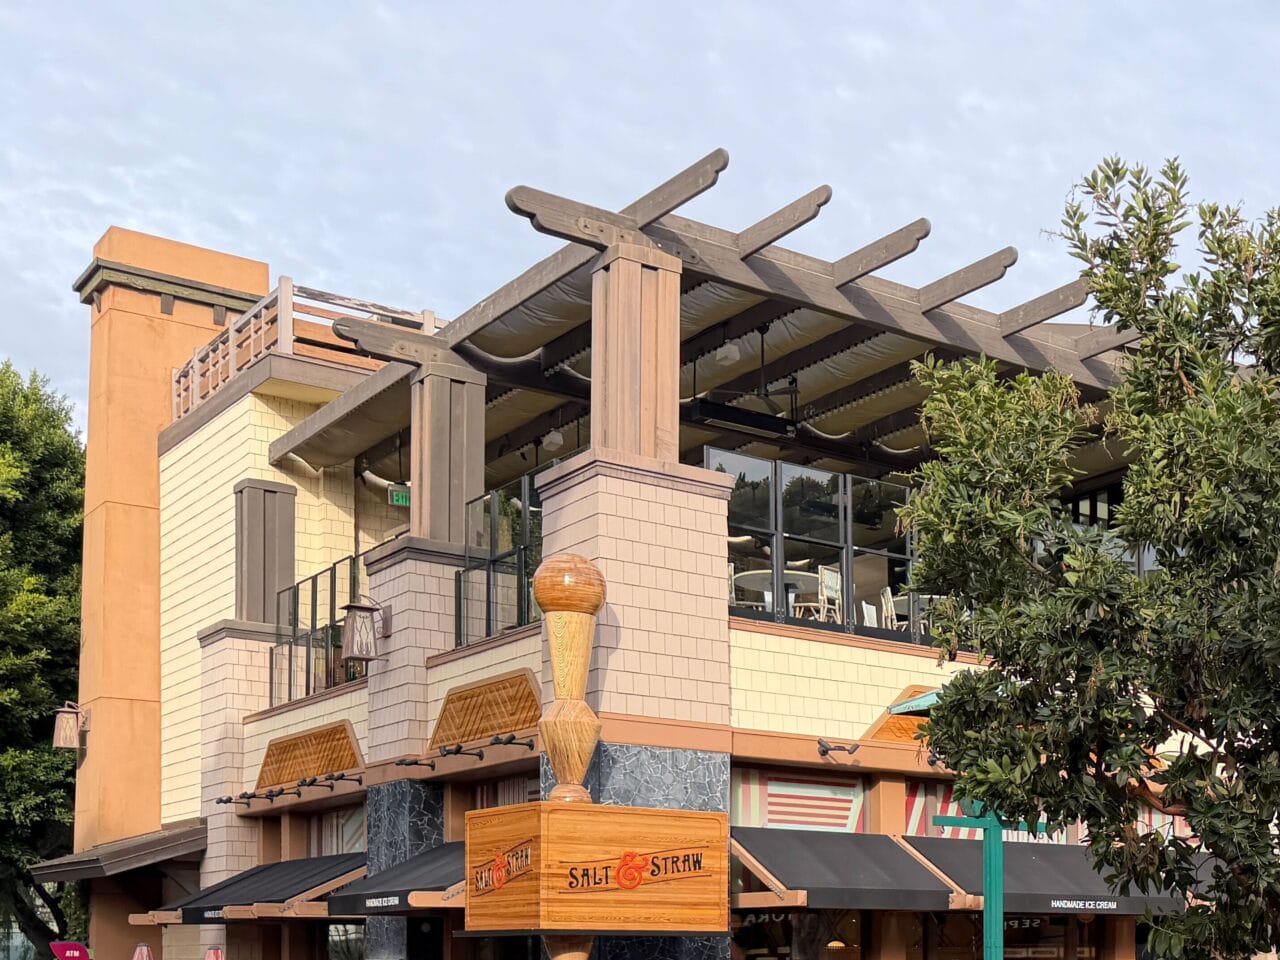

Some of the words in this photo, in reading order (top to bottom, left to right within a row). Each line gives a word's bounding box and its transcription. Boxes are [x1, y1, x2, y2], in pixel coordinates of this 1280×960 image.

[475, 868, 494, 892] SALT
[493, 852, 507, 890] &
[506, 847, 531, 876] STRAW
[568, 865, 612, 889] SALT
[615, 851, 649, 889] &
[650, 852, 704, 877] STRAW
[1051, 899, 1085, 909] HANDMADE
[1085, 901, 1095, 909] ICE
[1096, 901, 1117, 909] CREAM
[65, 949, 80, 958] ATM
